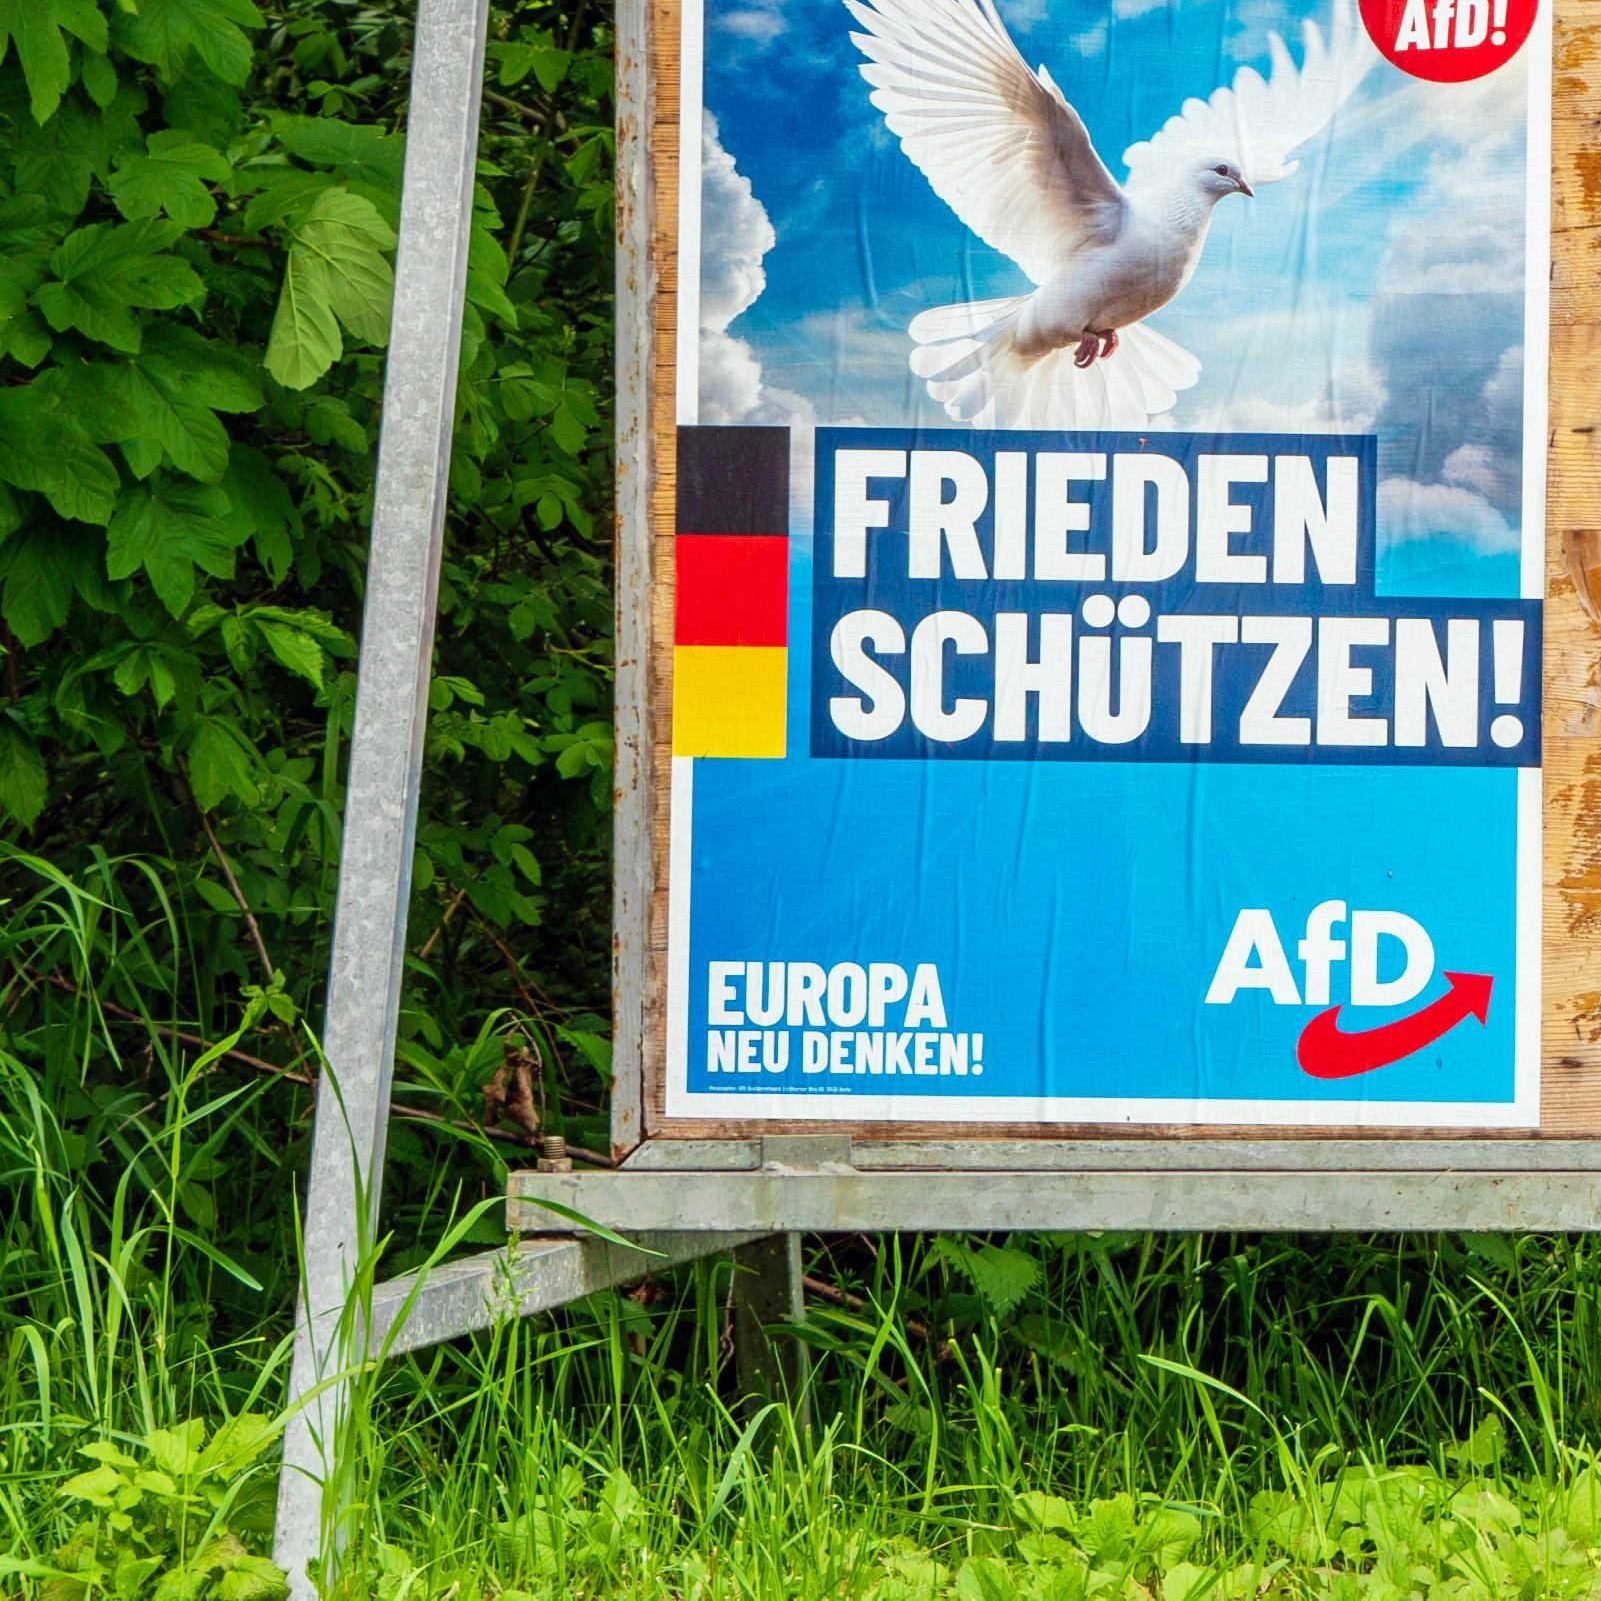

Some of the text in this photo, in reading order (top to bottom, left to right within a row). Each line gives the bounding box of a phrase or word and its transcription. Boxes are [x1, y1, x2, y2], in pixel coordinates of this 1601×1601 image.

[833, 448, 1358, 587] FRIEDEN
[829, 594, 1524, 750] SCHÜTZEN!
[707, 961, 948, 1030] EUROPA
[1205, 899, 1435, 1008] AfD
[707, 1030, 983, 1077] NEU DENKEN!
